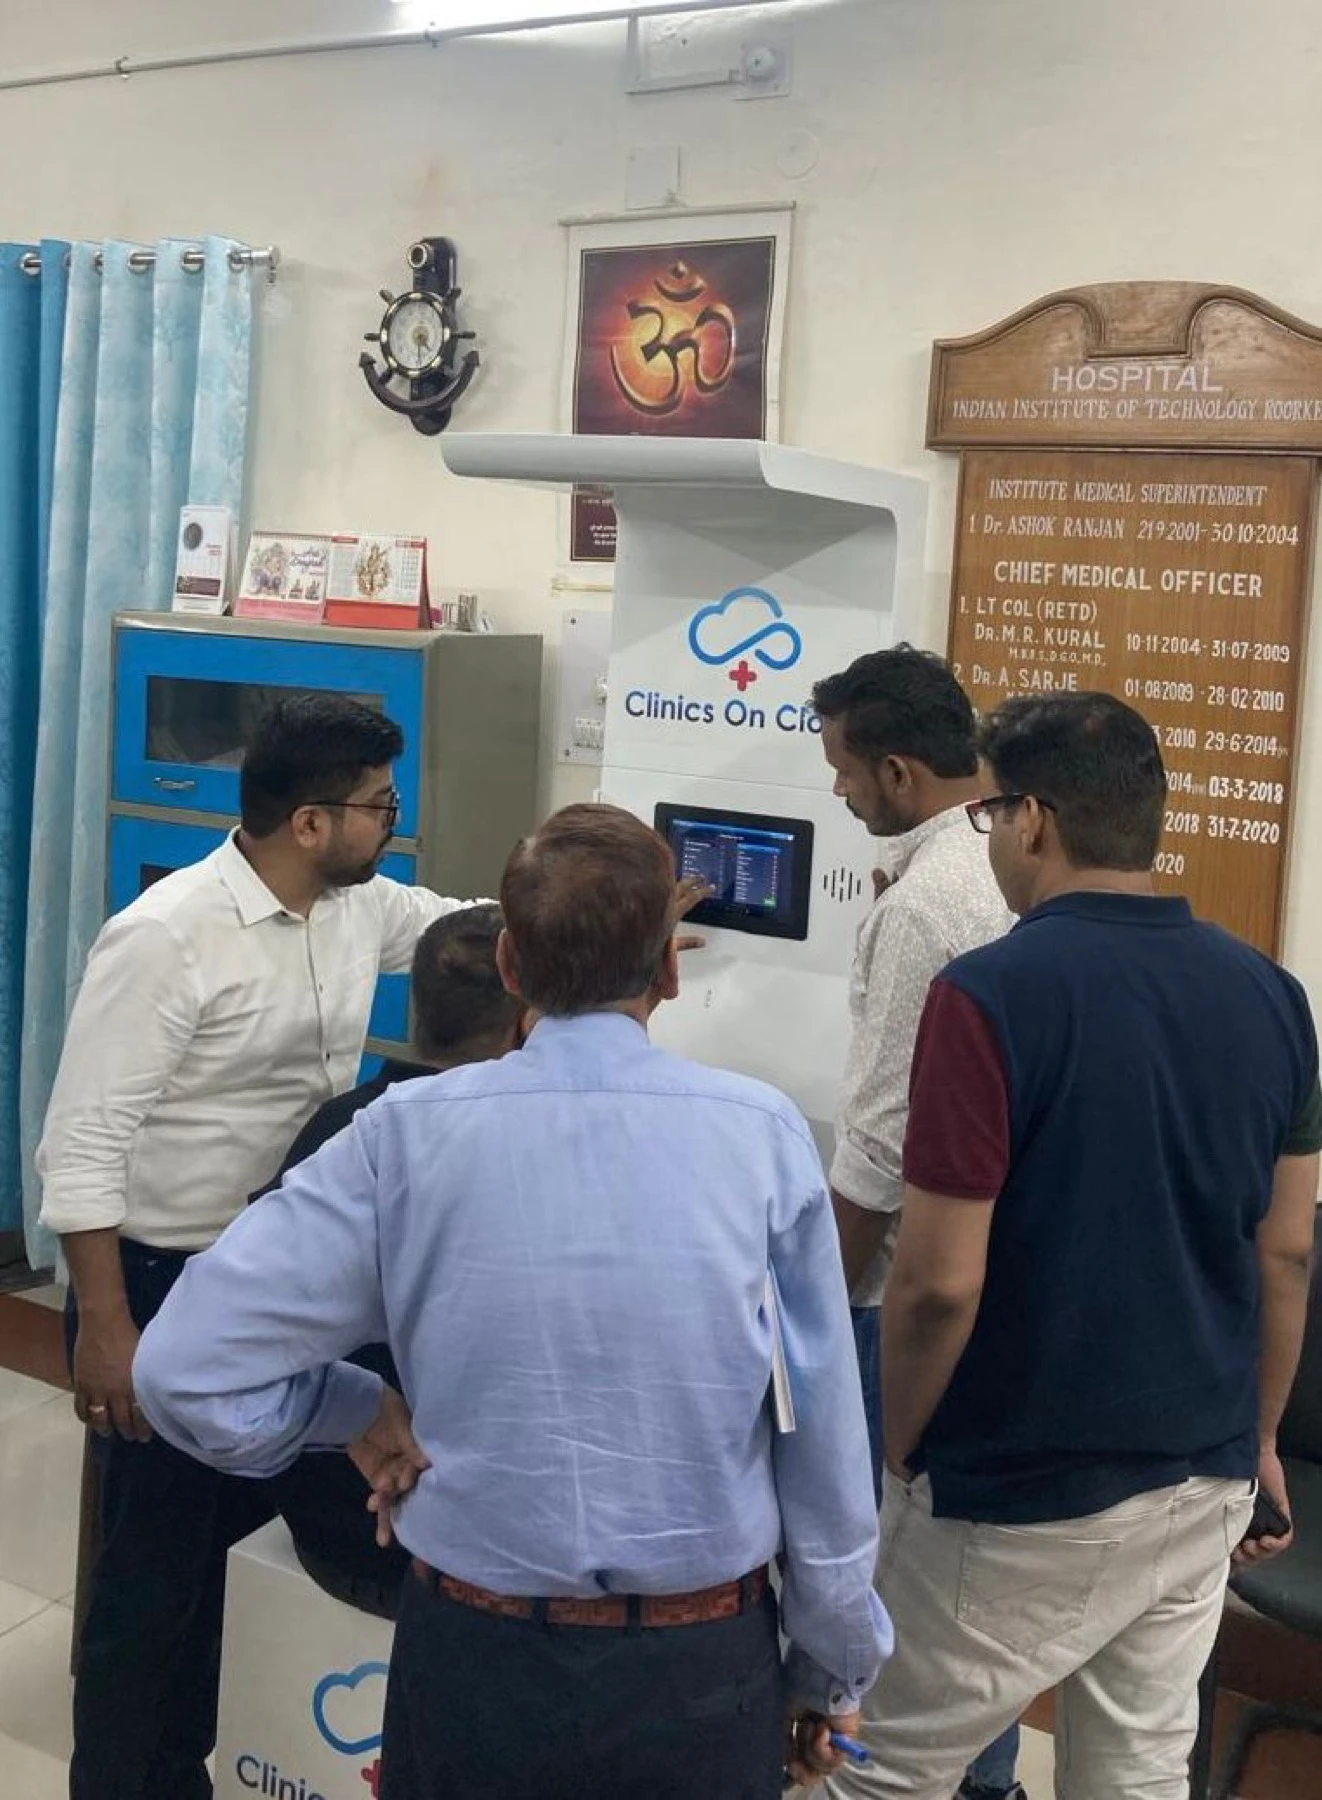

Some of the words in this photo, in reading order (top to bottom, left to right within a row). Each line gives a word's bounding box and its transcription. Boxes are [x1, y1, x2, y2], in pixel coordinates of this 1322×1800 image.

[1052, 365, 1223, 393] HOSPITAL
[952, 399, 1006, 419] INDIAN
[1012, 399, 1110, 419] INSTITUTE
[1115, 399, 1138, 419] OF
[1144, 399, 1257, 420] TECHNOLOGY
[990, 479, 1068, 501] INSTITUTE
[1074, 482, 1135, 503] MEDICAL
[1141, 484, 1267, 506] SUPERINTENDENT
[1007, 515, 1058, 537] ASHOK
[1063, 517, 1125, 539] RANJAN
[994, 561, 1056, 585] CHIEF
[1062, 563, 1152, 591] MEDICAL
[1160, 568, 1262, 598] OFFICER
[976, 597, 997, 614] LT
[1002, 598, 1033, 617] COL
[1037, 597, 1098, 624] (RETD)
[1044, 627, 1105, 649] KURAL
[1018, 667, 1078, 693] SARJE
[625, 690, 714, 724] Clinics
[724, 699, 766, 727] On
[1165, 811, 1200, 835] 2018
[1151, 852, 1185, 876] 020
